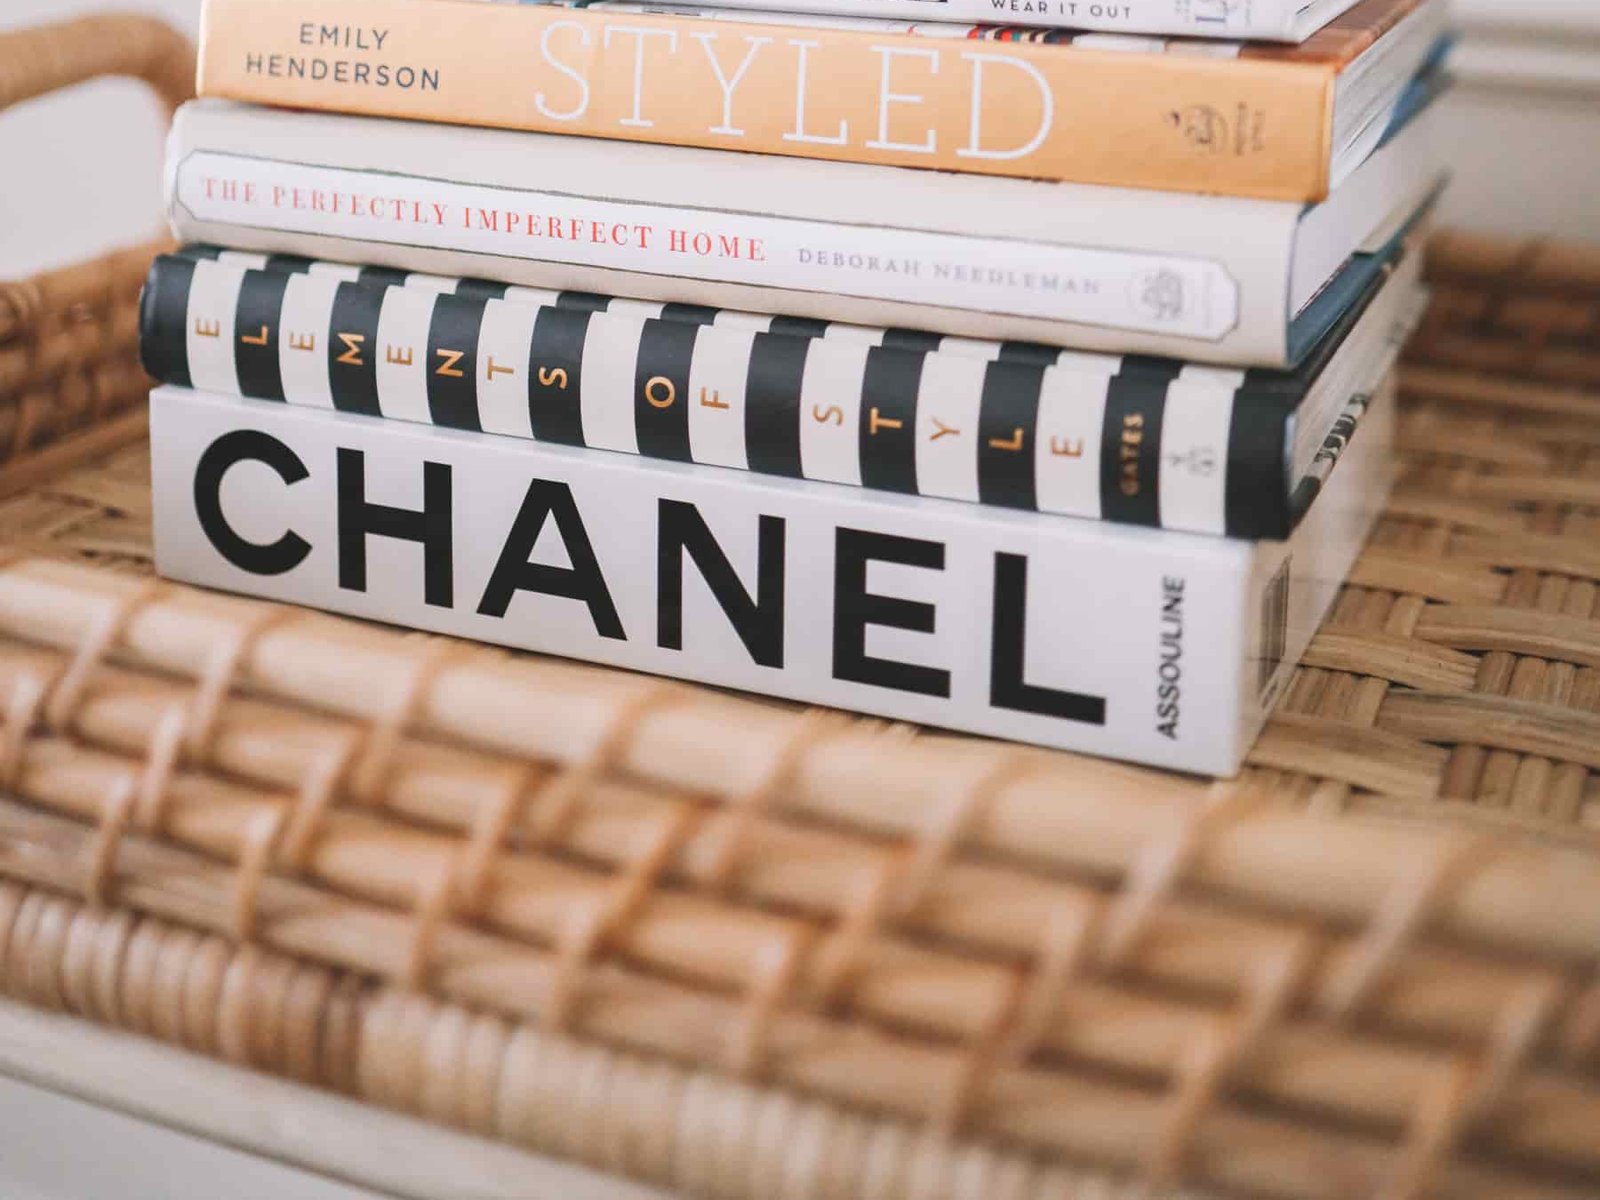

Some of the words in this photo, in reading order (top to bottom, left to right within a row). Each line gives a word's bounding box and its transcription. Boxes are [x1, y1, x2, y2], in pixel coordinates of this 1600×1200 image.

[246, 52, 440, 91] HENDERSON
[299, 22, 389, 51] EMILY
[1060, 2, 1078, 15] IT
[1089, 4, 1132, 19] OUT
[534, 20, 1055, 161] STYLED
[204, 177, 257, 204] THE
[272, 185, 449, 227] PERFECTLY
[464, 206, 654, 250] IMPERFECT
[668, 229, 768, 263] HOME
[797, 246, 921, 277] DEBORAH
[932, 262, 1102, 296] NEEDLEMAN
[195, 318, 568, 391] ELEMENTS
[643, 375, 731, 411] OF
[811, 402, 1085, 461] STYLE
[193, 428, 1106, 726] CHANEL
[1152, 574, 1187, 740] ASSOULINE
